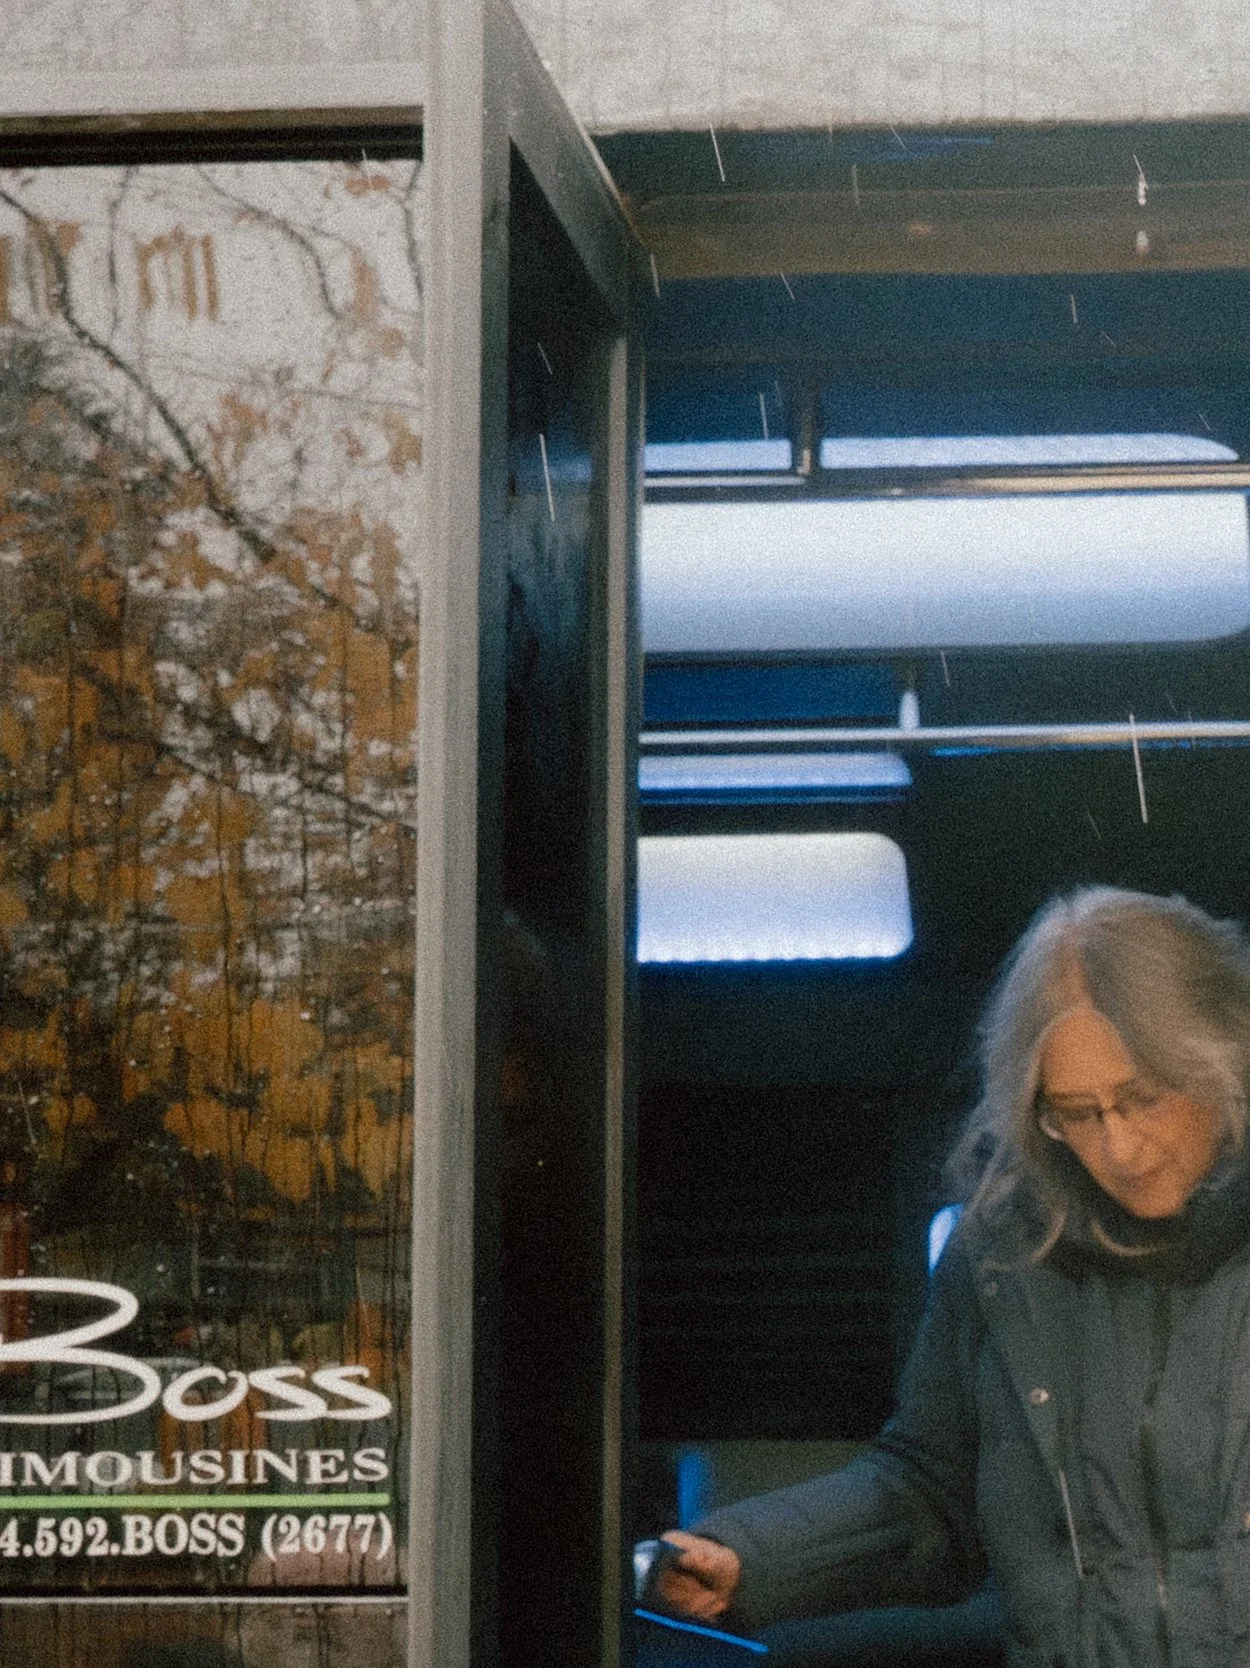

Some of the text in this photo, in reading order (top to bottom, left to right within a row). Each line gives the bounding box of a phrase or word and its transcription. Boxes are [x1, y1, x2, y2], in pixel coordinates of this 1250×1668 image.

[0, 1277, 392, 1424] Boss
[0, 1447, 389, 1487] IMOUSINES
[0, 1512, 393, 1562] 4.592.BOSS (2677)
